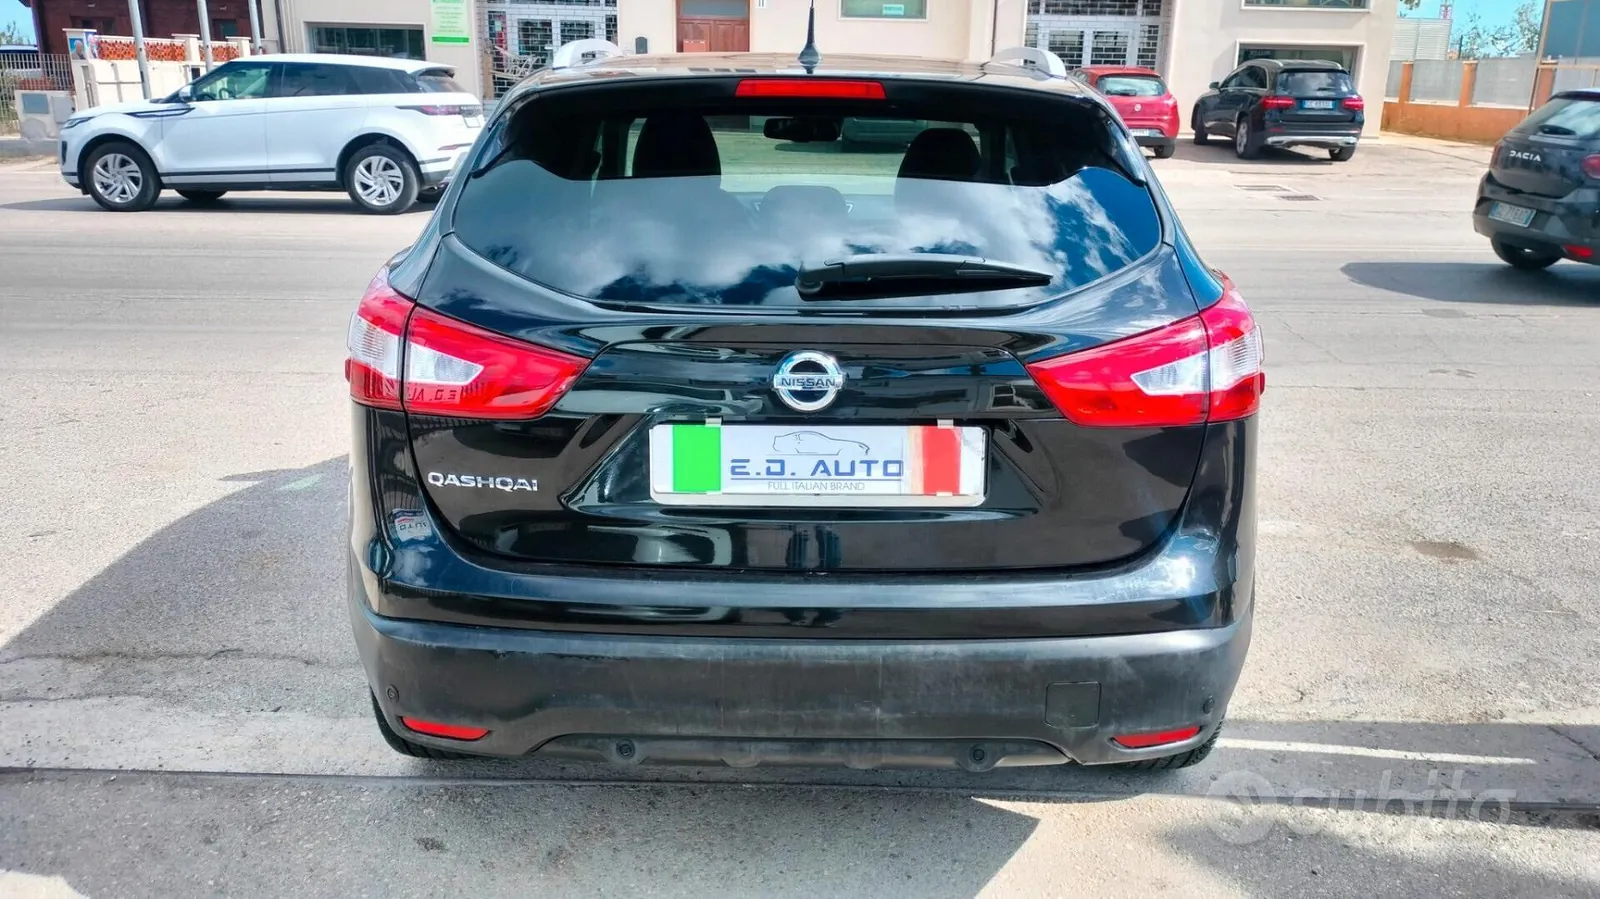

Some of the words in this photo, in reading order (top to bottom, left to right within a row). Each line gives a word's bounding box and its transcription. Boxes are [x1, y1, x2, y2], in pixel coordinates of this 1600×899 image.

[1510, 150, 1541, 161] DACIA
[781, 377, 836, 387] NISSAN
[730, 458, 796, 477] E.D.
[810, 458, 904, 477] AUTO
[428, 472, 538, 492] QASHQAI
[767, 480, 791, 491] FULL
[791, 480, 828, 491] ITALIAN
[829, 480, 866, 491] BRAND
